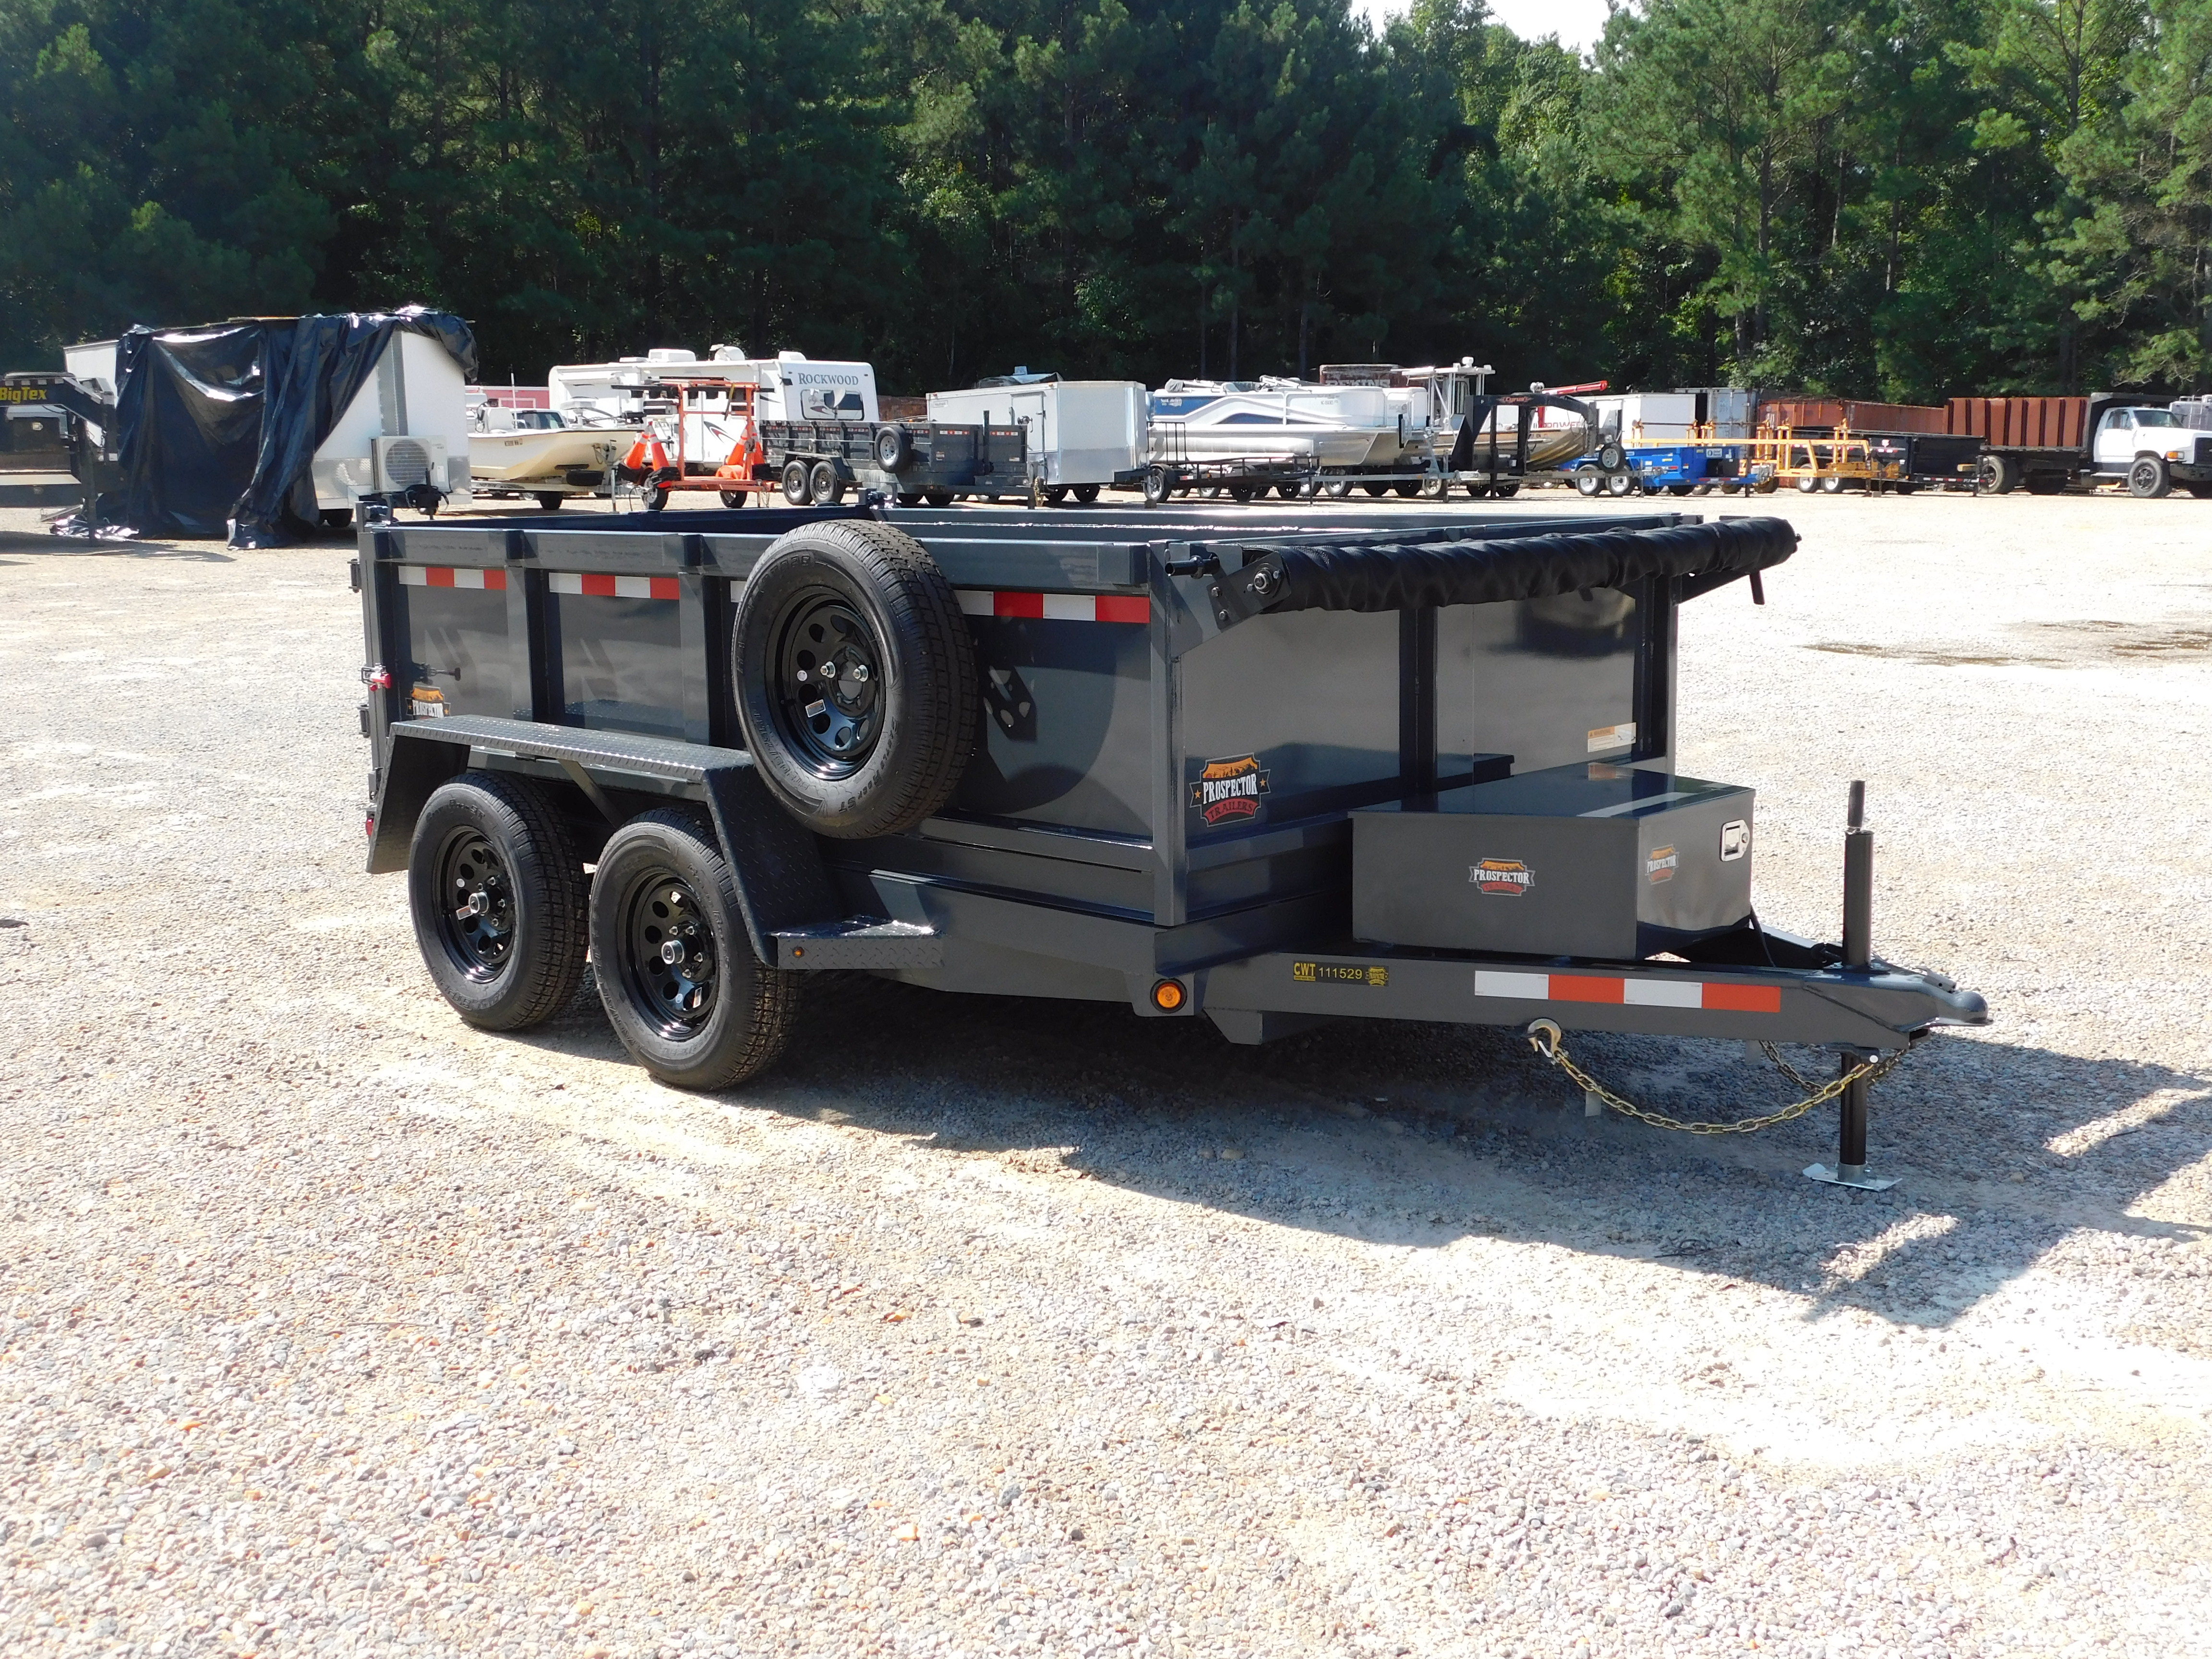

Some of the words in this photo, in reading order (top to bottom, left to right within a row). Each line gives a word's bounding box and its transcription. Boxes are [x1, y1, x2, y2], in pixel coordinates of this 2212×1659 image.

[798, 373, 859, 385] ROCKWOOD
[0, 386, 47, 404] BigTex
[1202, 773, 1258, 805] PROSPECTOR
[1208, 800, 1254, 819] TRAILERS
[1647, 855, 1676, 873] PROSPECTOR
[1473, 869, 1530, 884] PROSPECTOR
[1294, 962, 1316, 976] CWT
[1319, 967, 1362, 979] 111529
